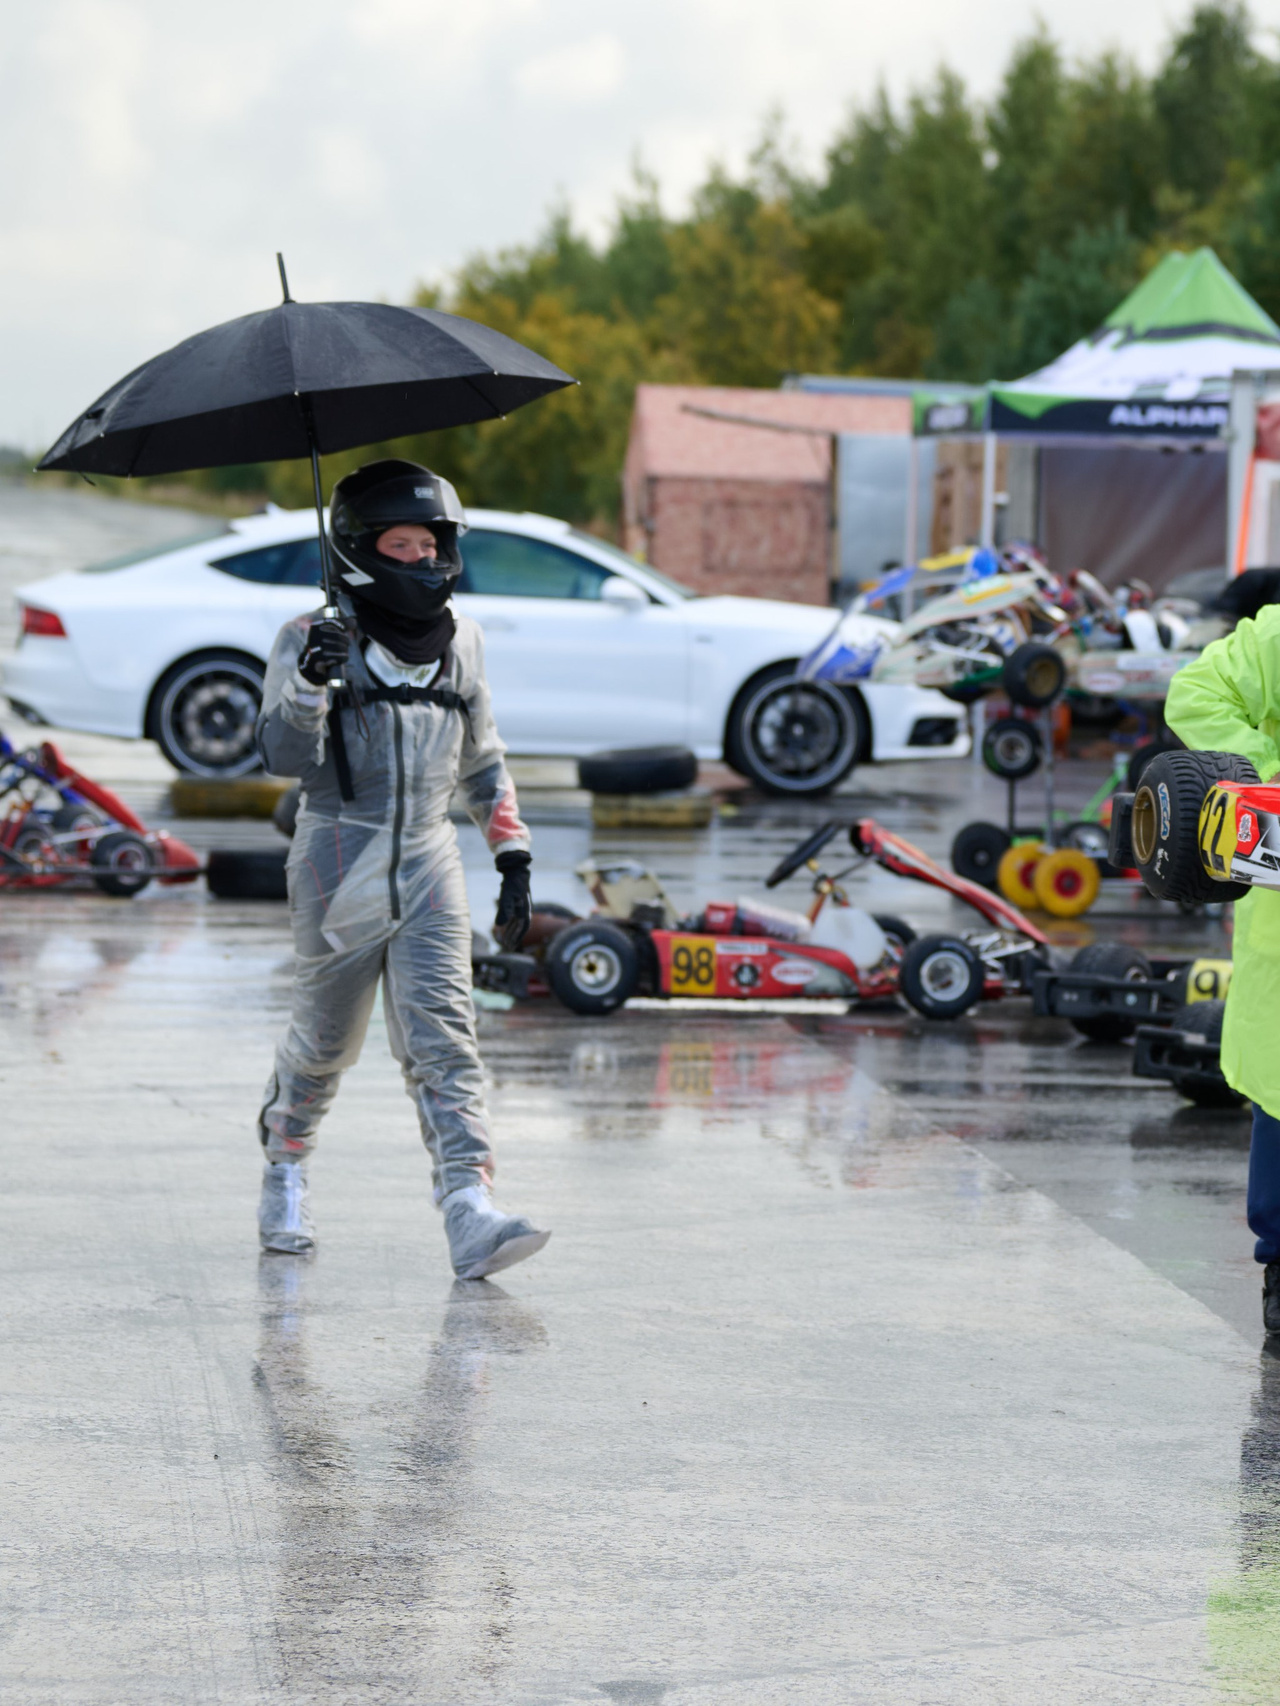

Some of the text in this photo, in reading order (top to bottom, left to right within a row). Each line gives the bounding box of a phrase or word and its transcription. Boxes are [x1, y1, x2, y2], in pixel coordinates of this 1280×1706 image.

[1158, 784, 1171, 837] VEGA
[1200, 788, 1229, 873] 22
[673, 947, 714, 985] 98
